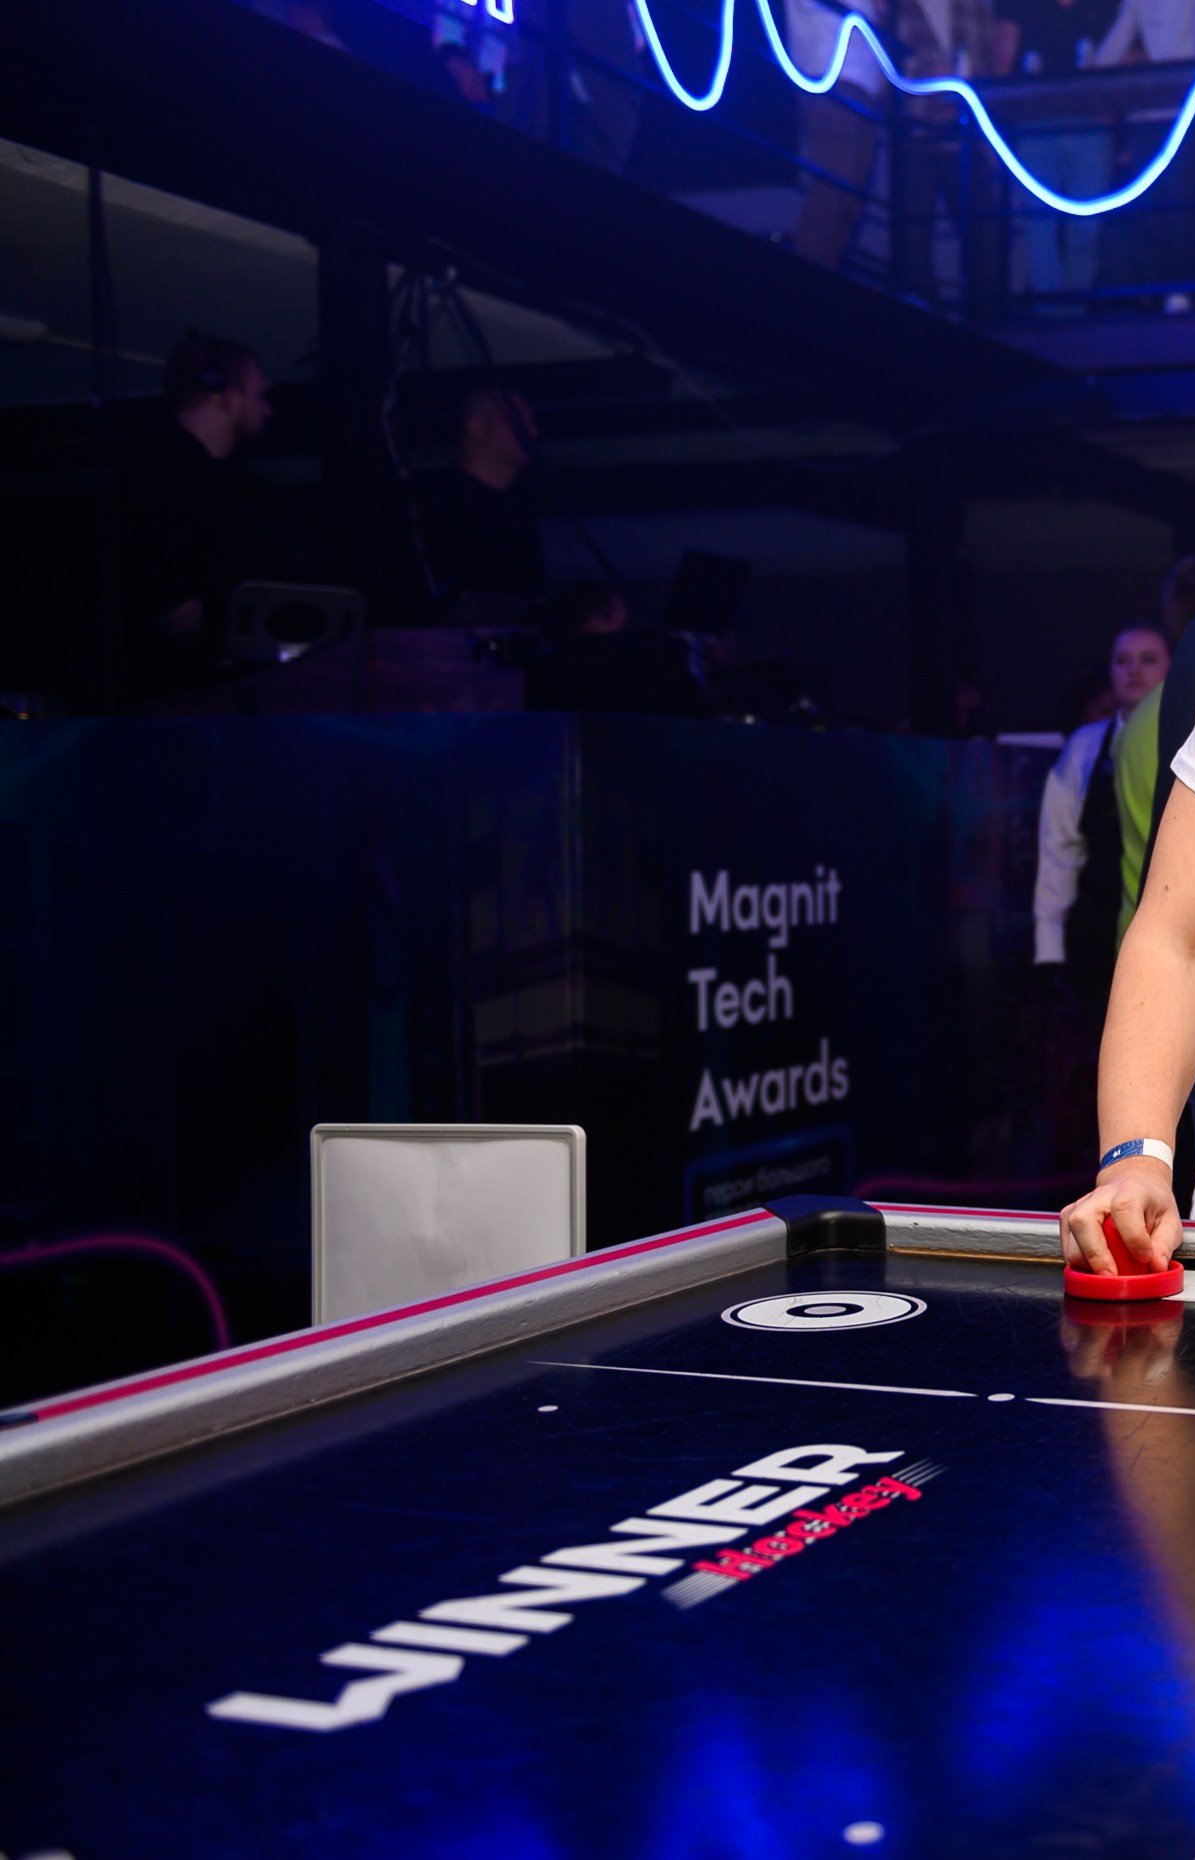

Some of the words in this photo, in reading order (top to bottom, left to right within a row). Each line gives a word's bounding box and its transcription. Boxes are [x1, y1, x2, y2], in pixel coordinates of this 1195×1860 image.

[689, 864, 842, 949] Magnit
[688, 953, 793, 1032] Tech
[689, 1037, 850, 1131] Awards
[692, 1475, 922, 1581] Hockey
[207, 1444, 905, 1732] WINNER
